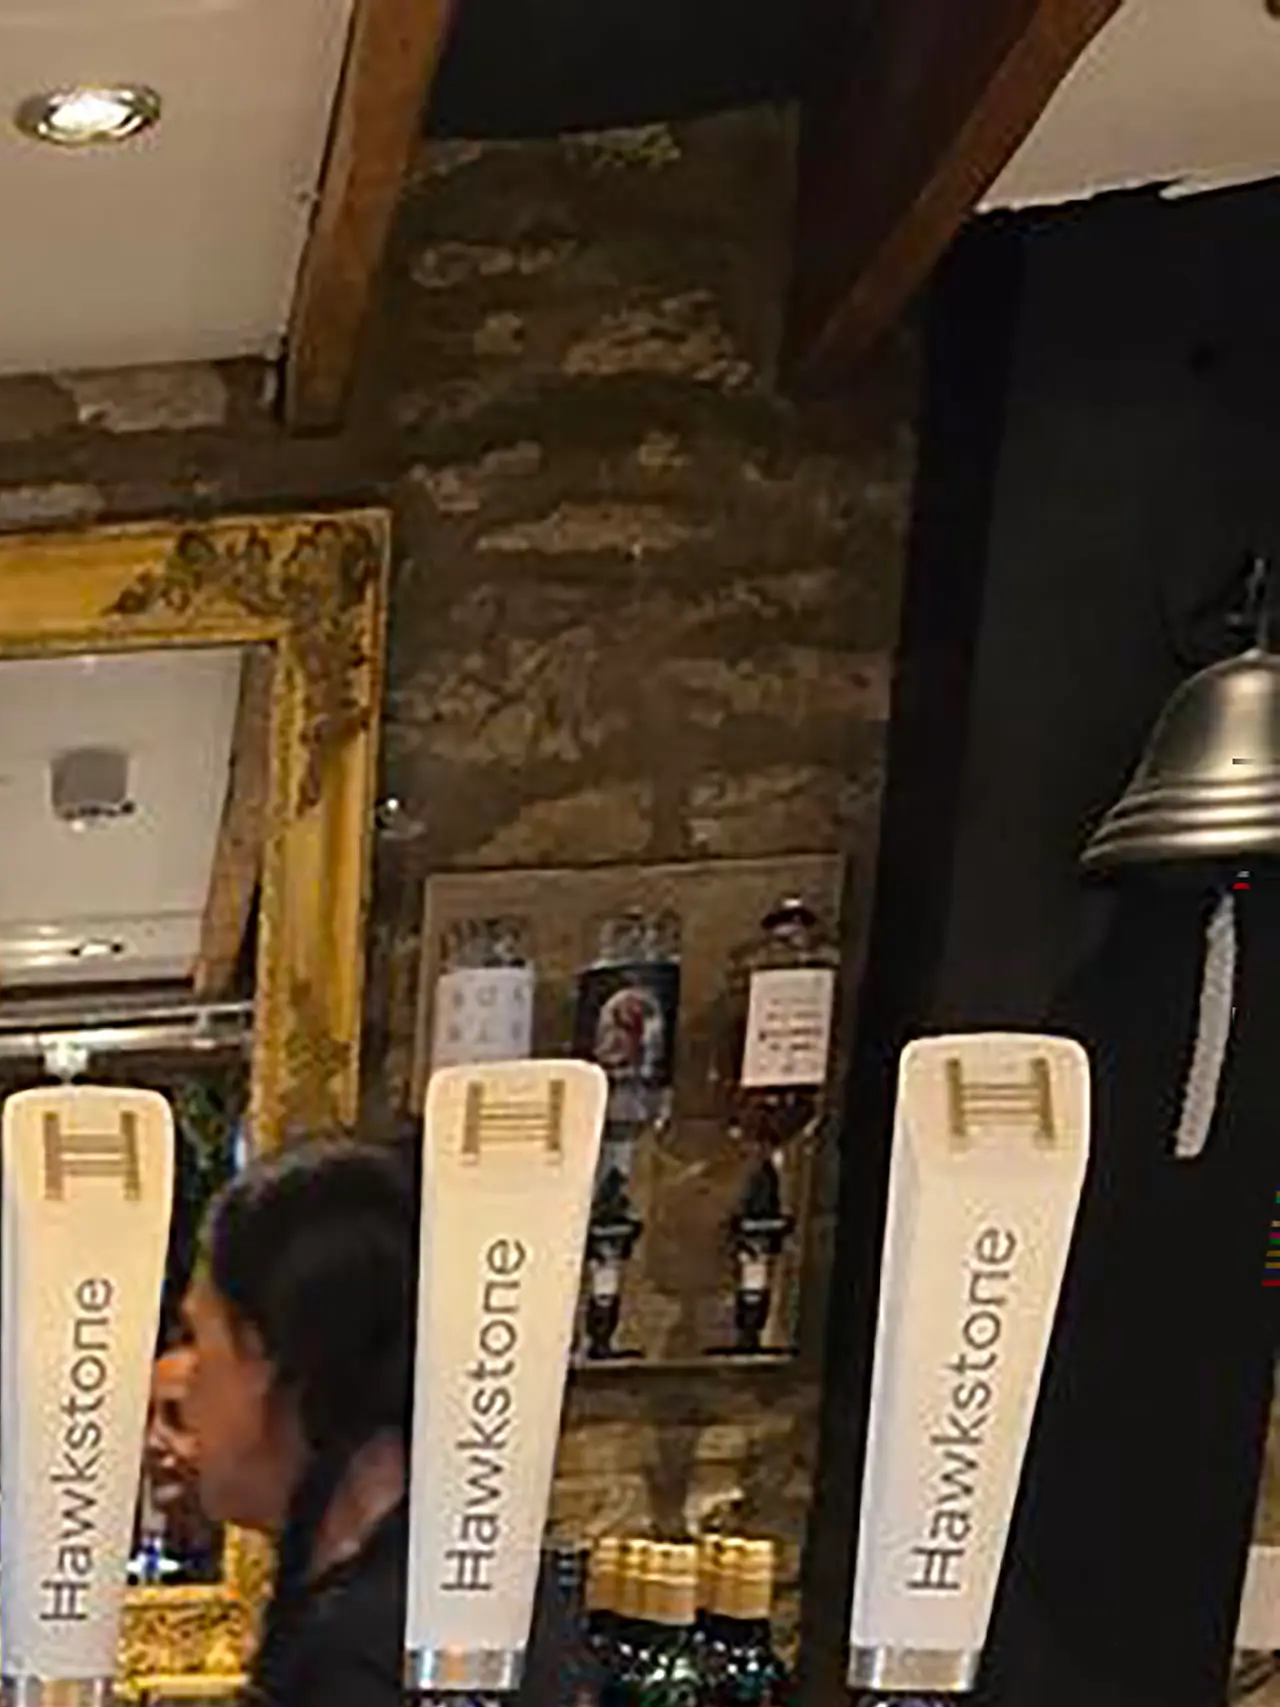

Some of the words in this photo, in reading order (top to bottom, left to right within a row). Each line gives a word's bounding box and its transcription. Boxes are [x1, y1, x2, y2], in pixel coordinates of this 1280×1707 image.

[40, 1275, 115, 1622] Hawkstone
[441, 1237, 527, 1592] Hawkstone
[904, 1226, 1017, 1592] Hawkstone
